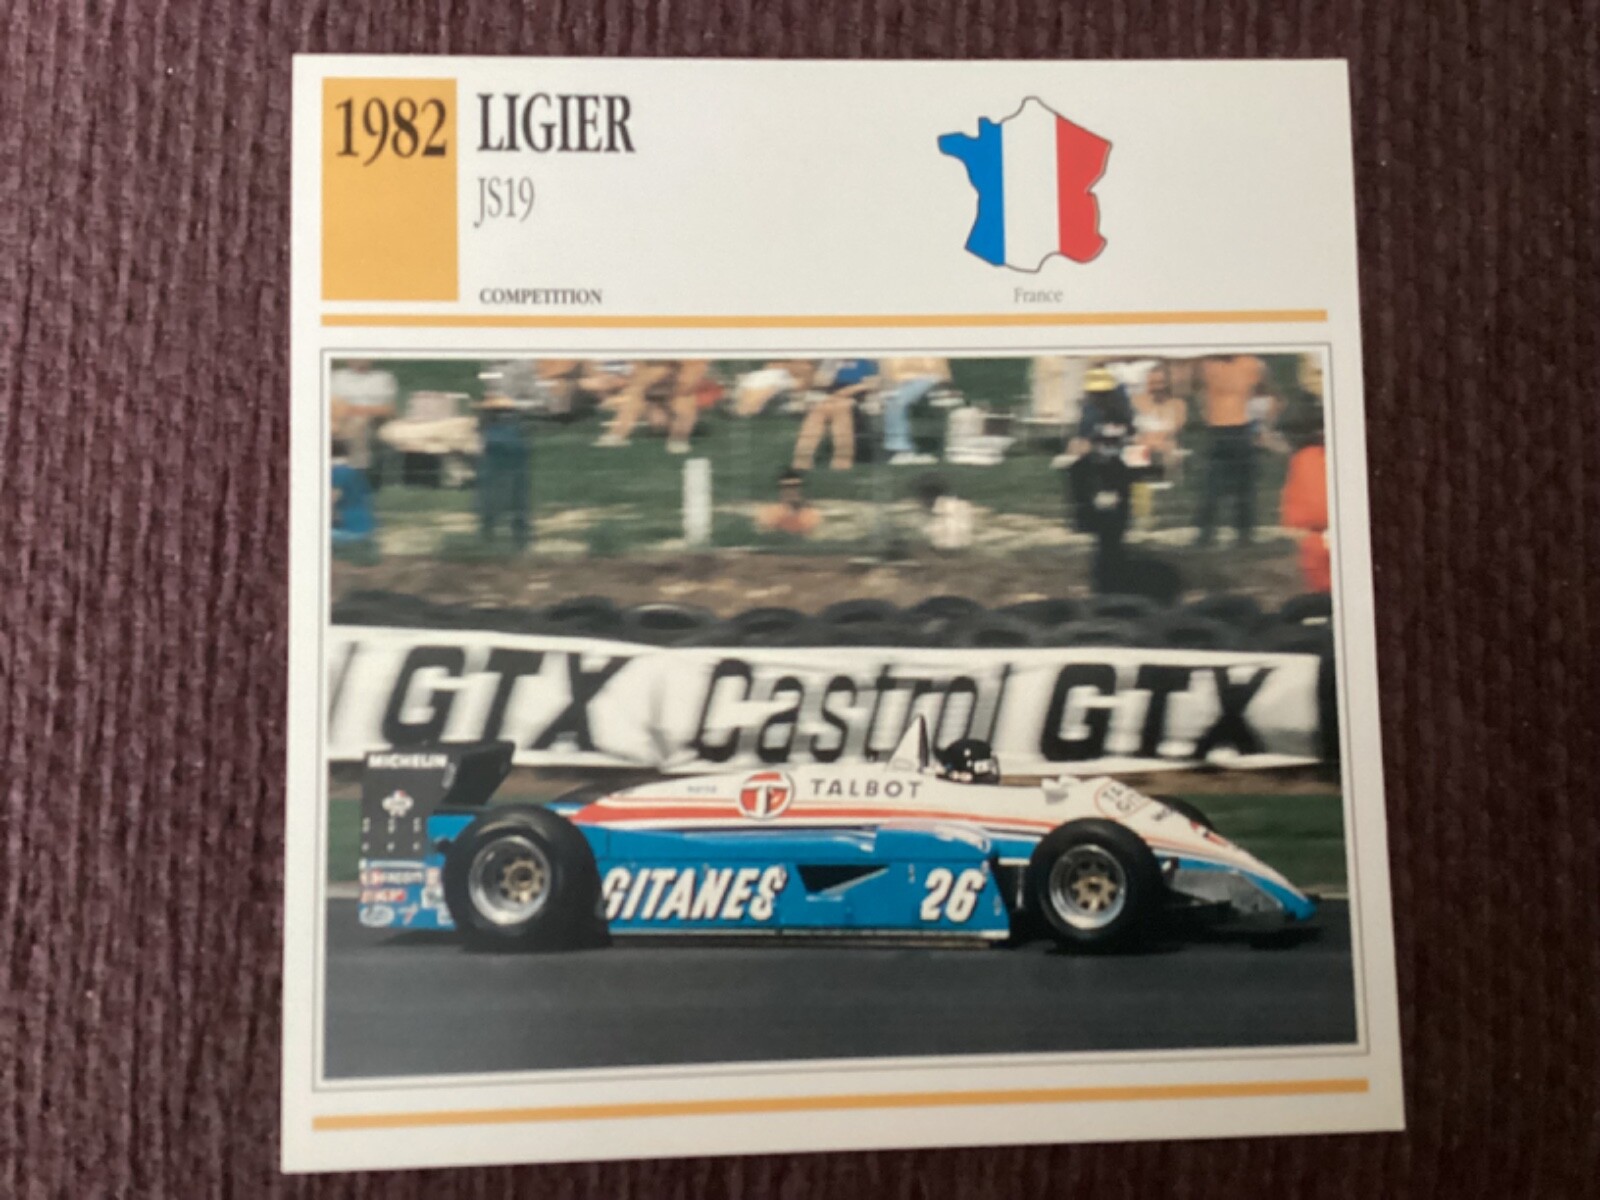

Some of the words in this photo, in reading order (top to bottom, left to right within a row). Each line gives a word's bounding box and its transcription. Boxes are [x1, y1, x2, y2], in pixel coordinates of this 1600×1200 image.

[334, 96, 448, 167] 1982
[476, 92, 636, 154] LIGIER
[473, 176, 535, 229] JS19
[479, 287, 603, 305] COMPETITION
[1013, 287, 1064, 304] France
[383, 644, 635, 753] GTX
[692, 657, 1013, 764] Castrol
[1040, 663, 1279, 761] GTX
[367, 753, 449, 769] MICHELIN
[810, 777, 923, 800] TALBOT
[602, 866, 789, 924] GITANES
[919, 867, 986, 924] 26
